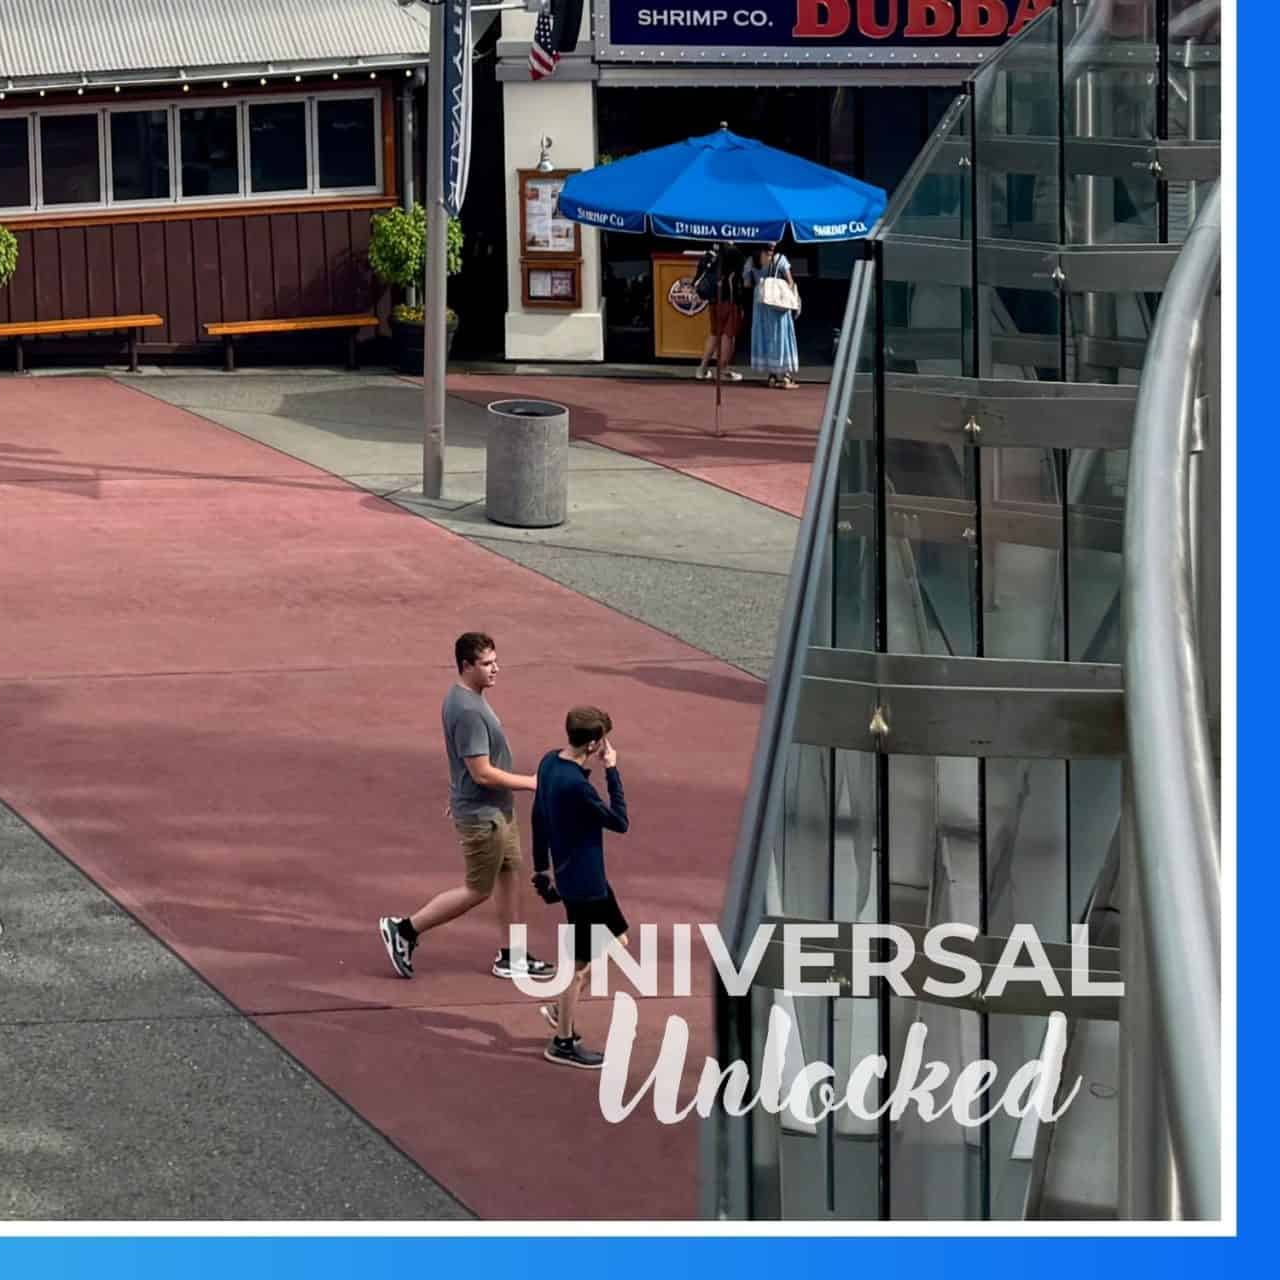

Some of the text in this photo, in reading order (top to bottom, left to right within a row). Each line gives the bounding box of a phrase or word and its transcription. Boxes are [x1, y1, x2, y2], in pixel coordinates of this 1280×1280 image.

[637, 8, 774, 28] SHRIMP CO.
[675, 221, 760, 238] BUBBA GUMP
[849, 220, 868, 233] CO.
